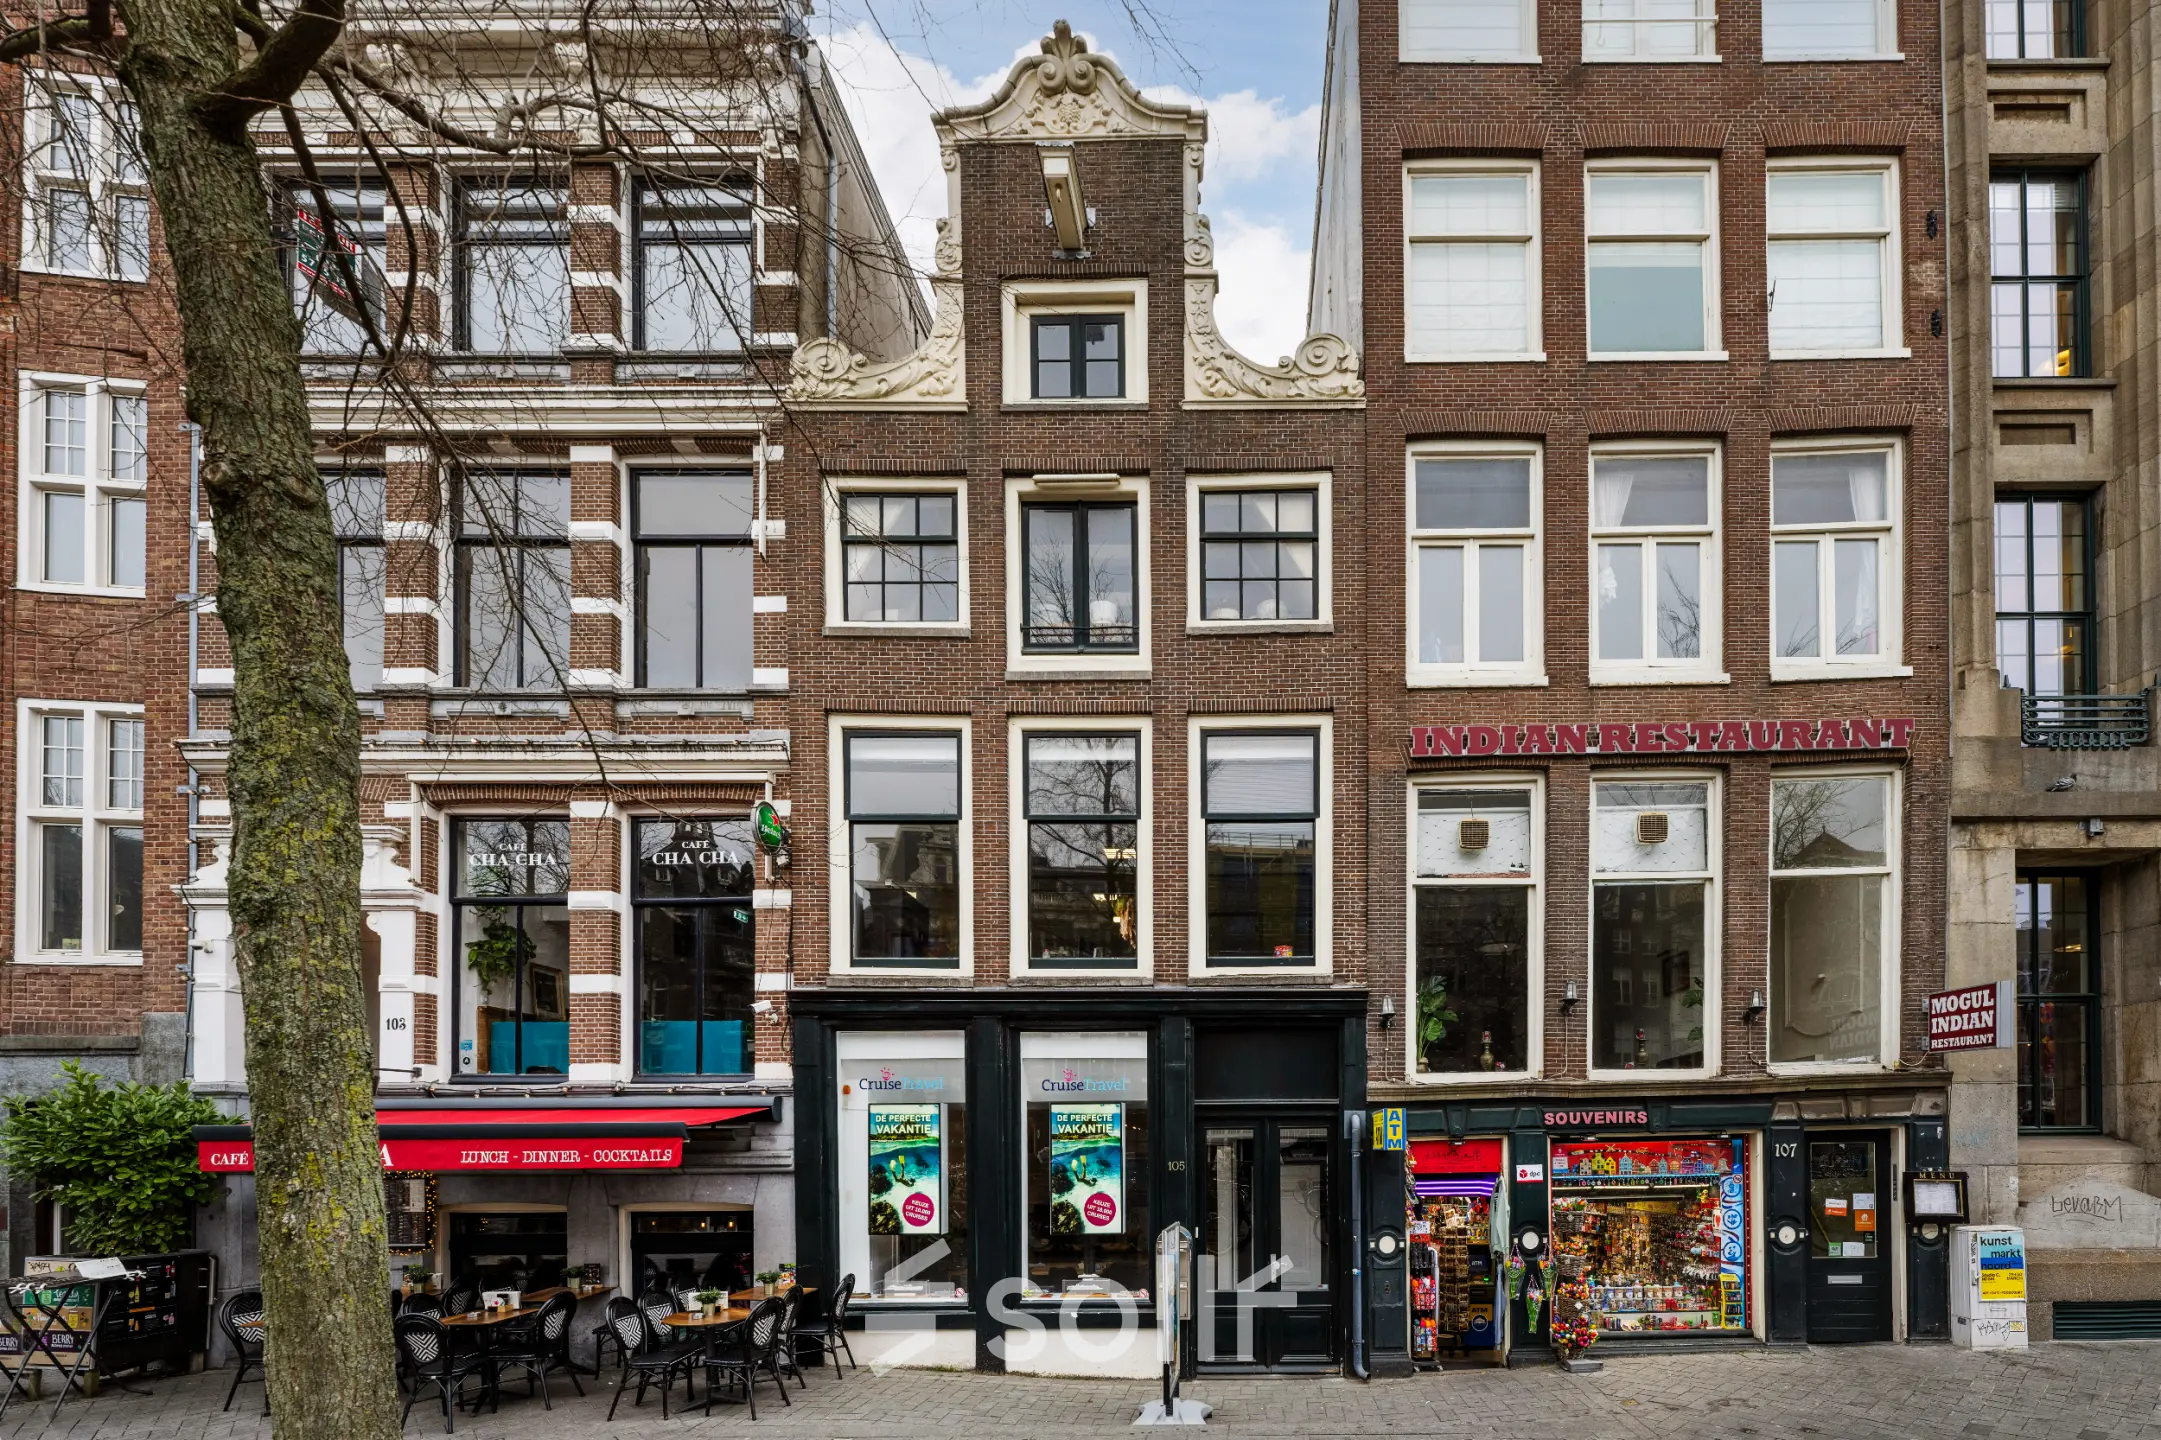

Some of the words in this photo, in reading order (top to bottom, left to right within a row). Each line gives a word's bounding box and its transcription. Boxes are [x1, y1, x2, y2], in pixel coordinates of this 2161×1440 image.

[1411, 724, 1589, 756] INDIAN
[1598, 719, 1915, 753] RESTAURANT
[681, 840, 710, 849] CAFÉ
[469, 853, 510, 866] CHA
[515, 852, 556, 866] CHA
[652, 852, 694, 865] CHA
[699, 850, 740, 864] CHA
[1931, 989, 1994, 1015] MOGUL
[386, 1017, 406, 1031] 103
[1931, 1010, 1994, 1034] INDIAN
[1931, 1033, 1994, 1049] RESTAURANT
[859, 1076, 944, 1090] CruiseTravel
[1041, 1077, 1127, 1091] CruiseTravel
[875, 1114, 887, 1122] DE
[889, 1114, 931, 1122] PERFECTE
[1544, 1111, 1648, 1125] SOUVENIRS
[876, 1124, 932, 1134] VAKANTIE
[1057, 1123, 1113, 1133] VAKANTIE
[1388, 1110, 1402, 1149] ATM
[460, 1151, 509, 1164] LUNCH
[522, 1150, 580, 1163] DINNER
[593, 1149, 673, 1162] COCKTAILS
[1775, 1143, 1797, 1158] 107
[210, 1151, 249, 1165] CAFÉ
[1168, 1161, 1185, 1171] 105
[1980, 1236, 2012, 1246] kunst
[1991, 1248, 2021, 1259] markt
[1981, 1261, 2011, 1270] noord
[52, 1334, 74, 1344] BERRY
